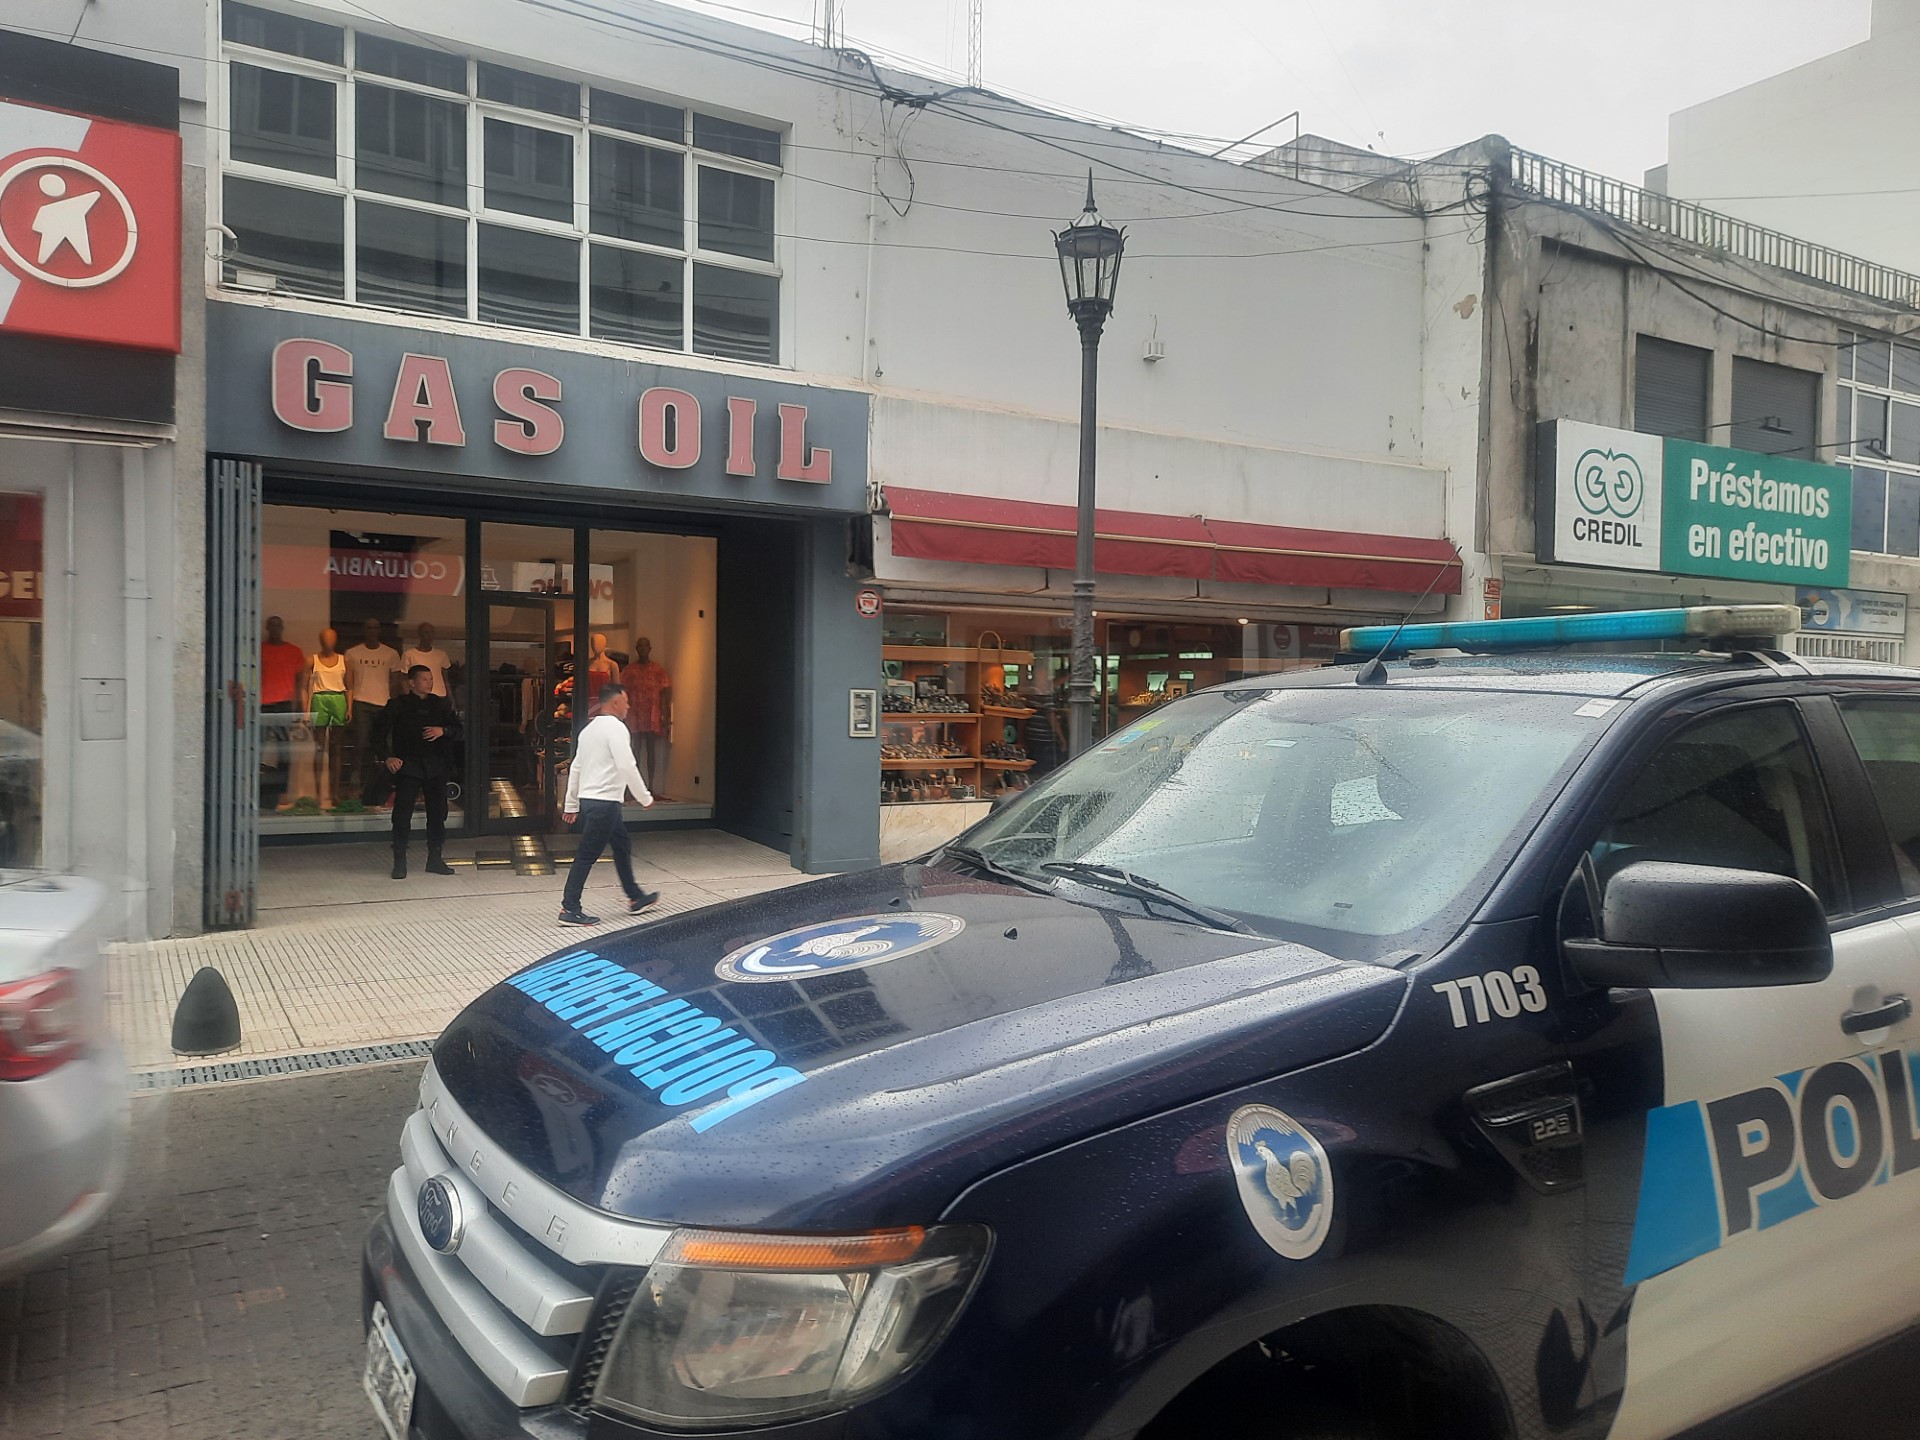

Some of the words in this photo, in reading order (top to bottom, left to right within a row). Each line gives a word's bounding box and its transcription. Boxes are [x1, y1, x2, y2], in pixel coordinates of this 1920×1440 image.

[271, 337, 566, 456] GAS
[637, 386, 833, 485] OIL
[1689, 458, 1829, 519] Préstamos
[1573, 517, 1642, 547] CREDIL
[1688, 523, 1721, 559] en
[1728, 521, 1828, 570] efectivo
[1431, 965, 1547, 1028] 7703
[1706, 1050, 1920, 1236] POL
[420, 1186, 444, 1238] Ford
